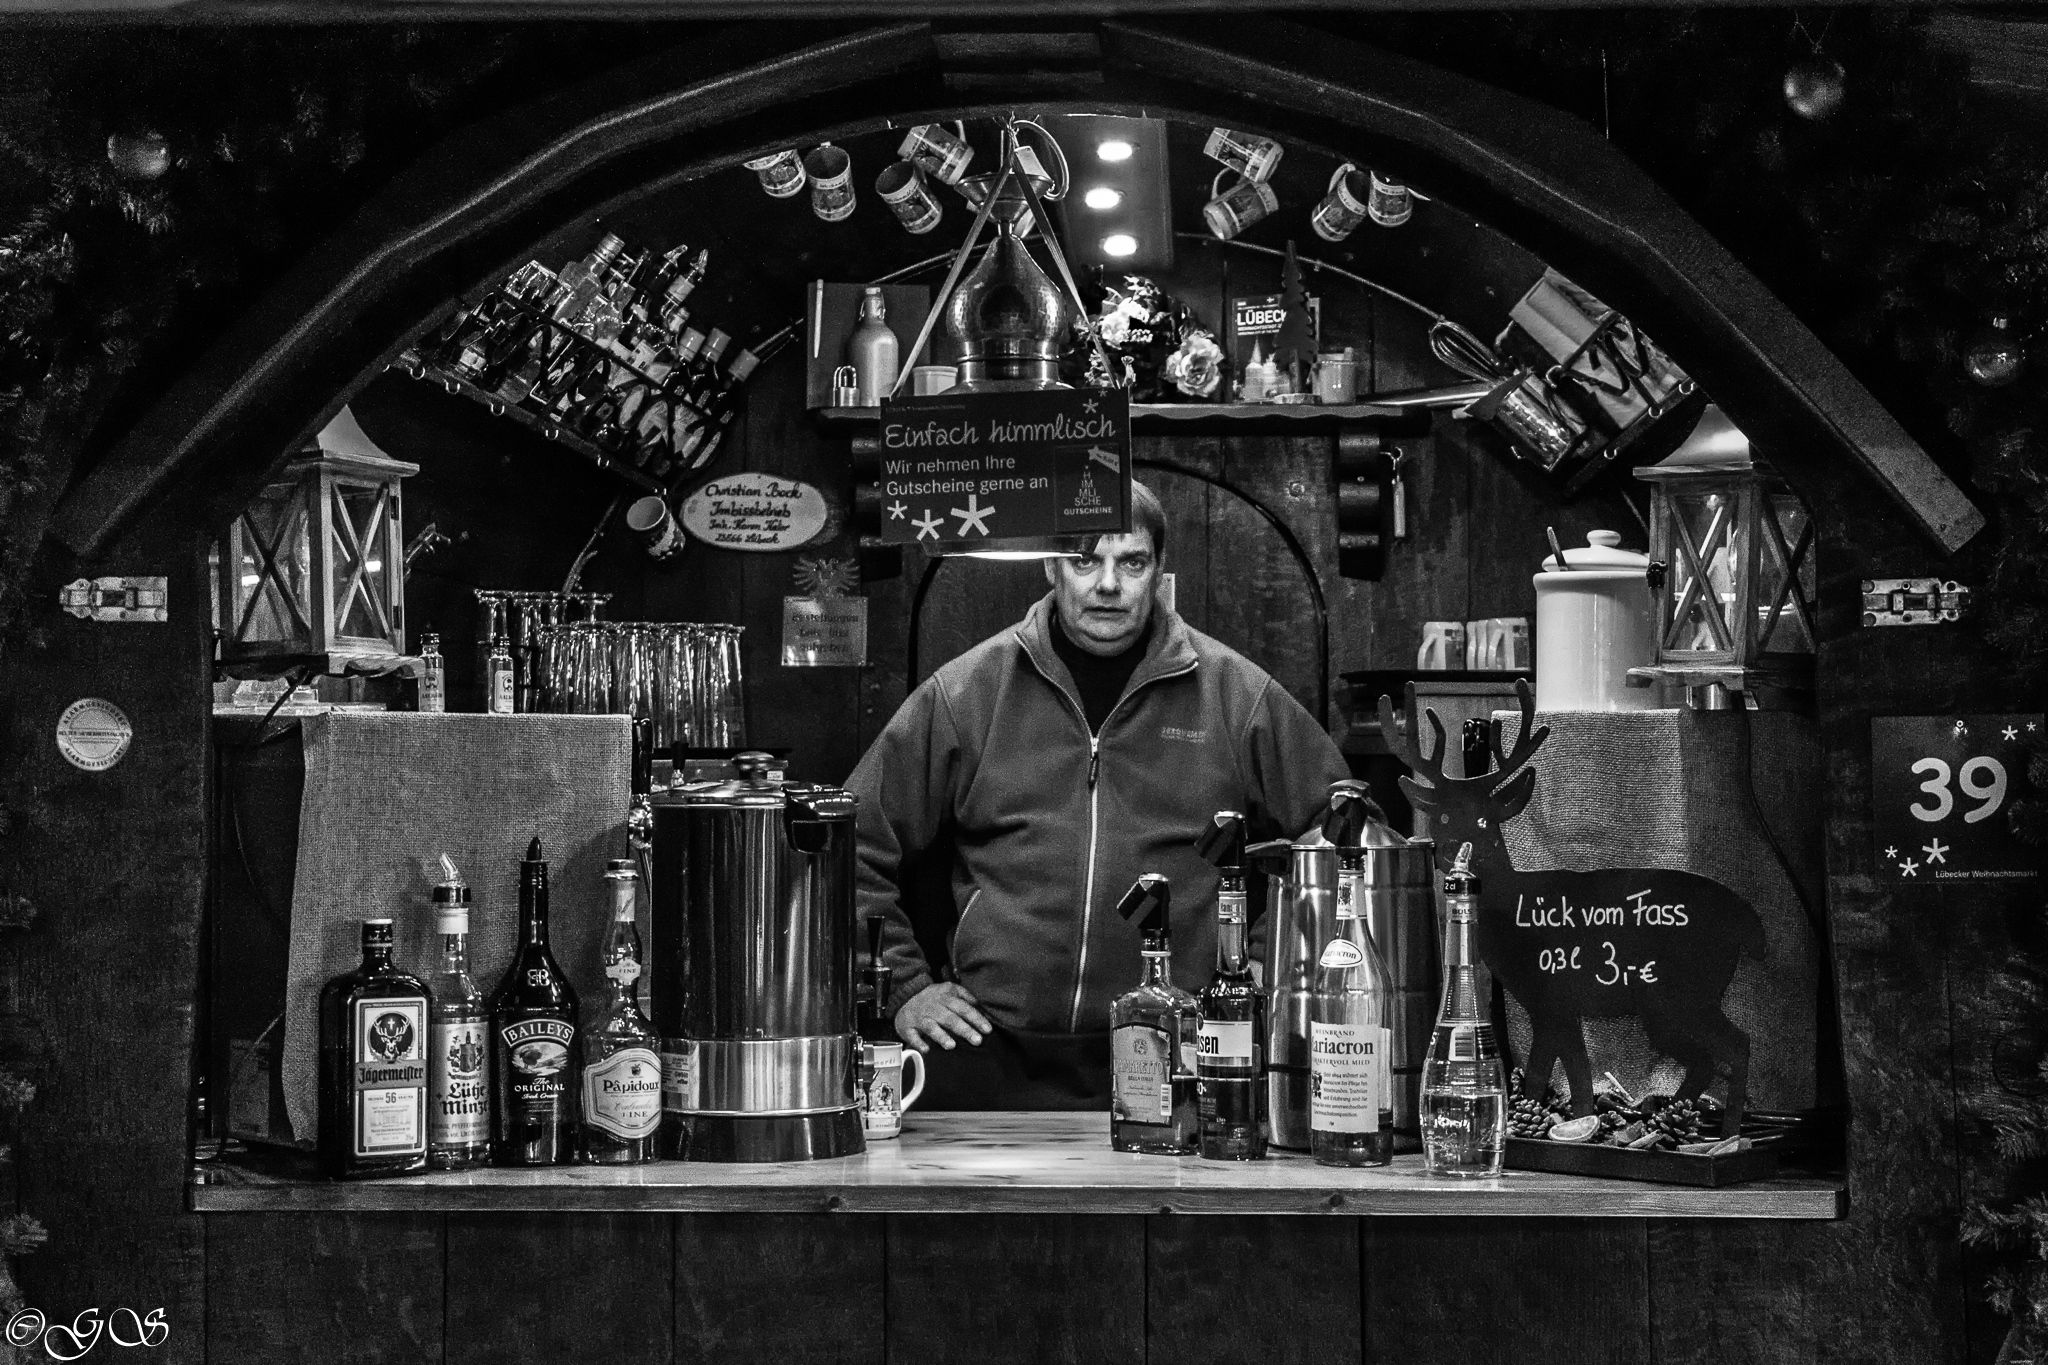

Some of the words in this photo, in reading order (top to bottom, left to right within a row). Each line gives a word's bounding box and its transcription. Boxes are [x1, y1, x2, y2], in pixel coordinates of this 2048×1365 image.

[885, 421, 979, 448] Einfach
[988, 413, 1116, 443] himmlisch
[886, 459, 912, 474] Wir
[917, 456, 980, 473] nehmen
[985, 455, 1016, 470] Ihre
[705, 481, 761, 497] Christian
[886, 478, 975, 496] Gutscheine
[980, 478, 1024, 495] gerne
[1029, 476, 1049, 489] an
[709, 501, 791, 518] Imbissbetrieb
[1074, 496, 1102, 507] SCHE
[1063, 506, 1113, 516] GUTSCHEINE
[1909, 755, 2008, 824] 39
[1935, 869, 1970, 879] Lübecker
[1971, 869, 2038, 879] Weihnachtsmarkt
[1515, 893, 1576, 928] Lück
[1581, 906, 1625, 927] vom
[1625, 888, 1689, 927] Fass
[509, 1023, 571, 1042] BAILEYS
[1312, 1037, 1375, 1055] ariacron
[358, 1067, 424, 1084] Jägermeister
[514, 1083, 565, 1092] ORIGINAL
[603, 1079, 660, 1094] Pâpidoux
[385, 1092, 397, 1104] 56
